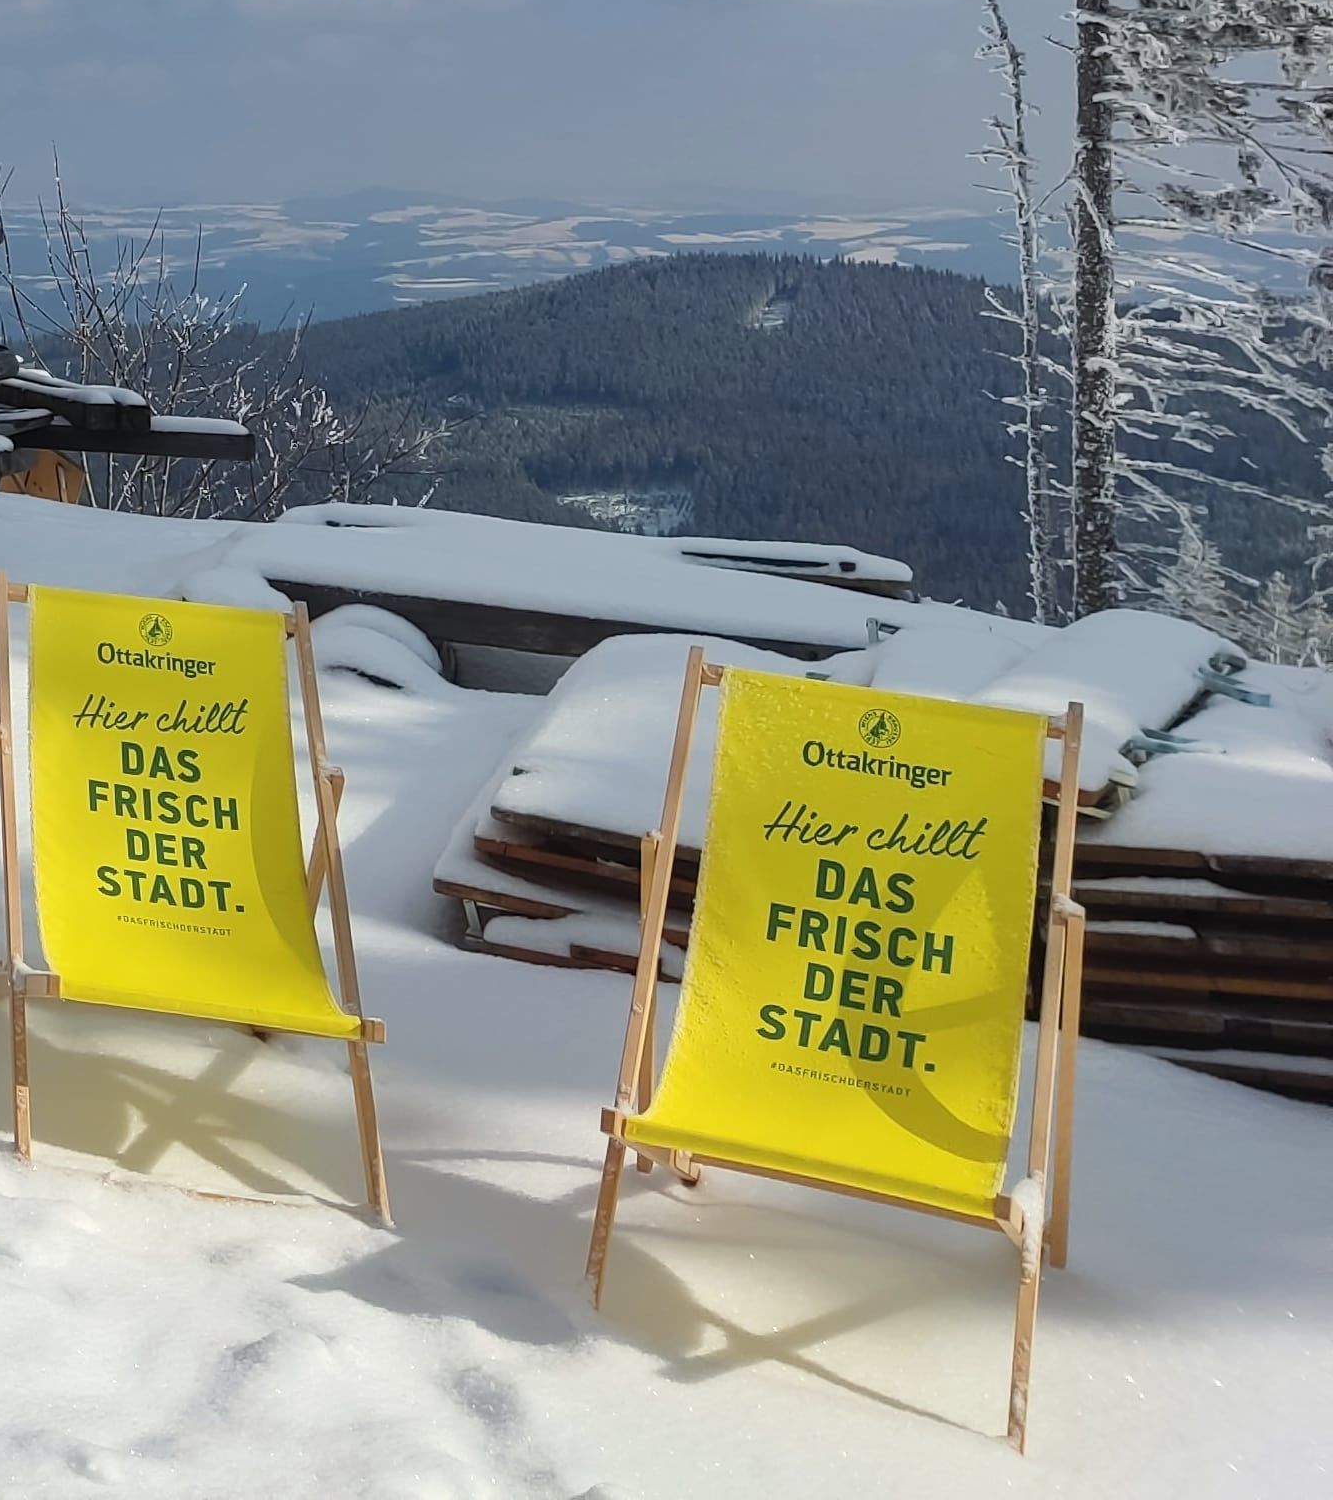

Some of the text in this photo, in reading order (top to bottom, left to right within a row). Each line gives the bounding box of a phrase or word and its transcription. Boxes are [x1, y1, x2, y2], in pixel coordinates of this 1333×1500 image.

[97, 642, 215, 678] Ottakringer
[72, 694, 248, 735] Hier chillt
[121, 741, 201, 781] DAS
[802, 740, 951, 788] Ottakringer
[88, 779, 239, 830] FRISCH
[126, 828, 206, 870] DER
[763, 800, 986, 860] Hier chillt
[97, 866, 245, 912] STADT.
[816, 859, 915, 913] DAS
[117, 915, 231, 937] #DASFRISCHDERSTADT
[766, 903, 953, 974] FRISCH
[803, 962, 903, 1018] DER
[756, 1004, 936, 1072] STADT.
[770, 1061, 911, 1097] #DASFRISCHDERSTADT
